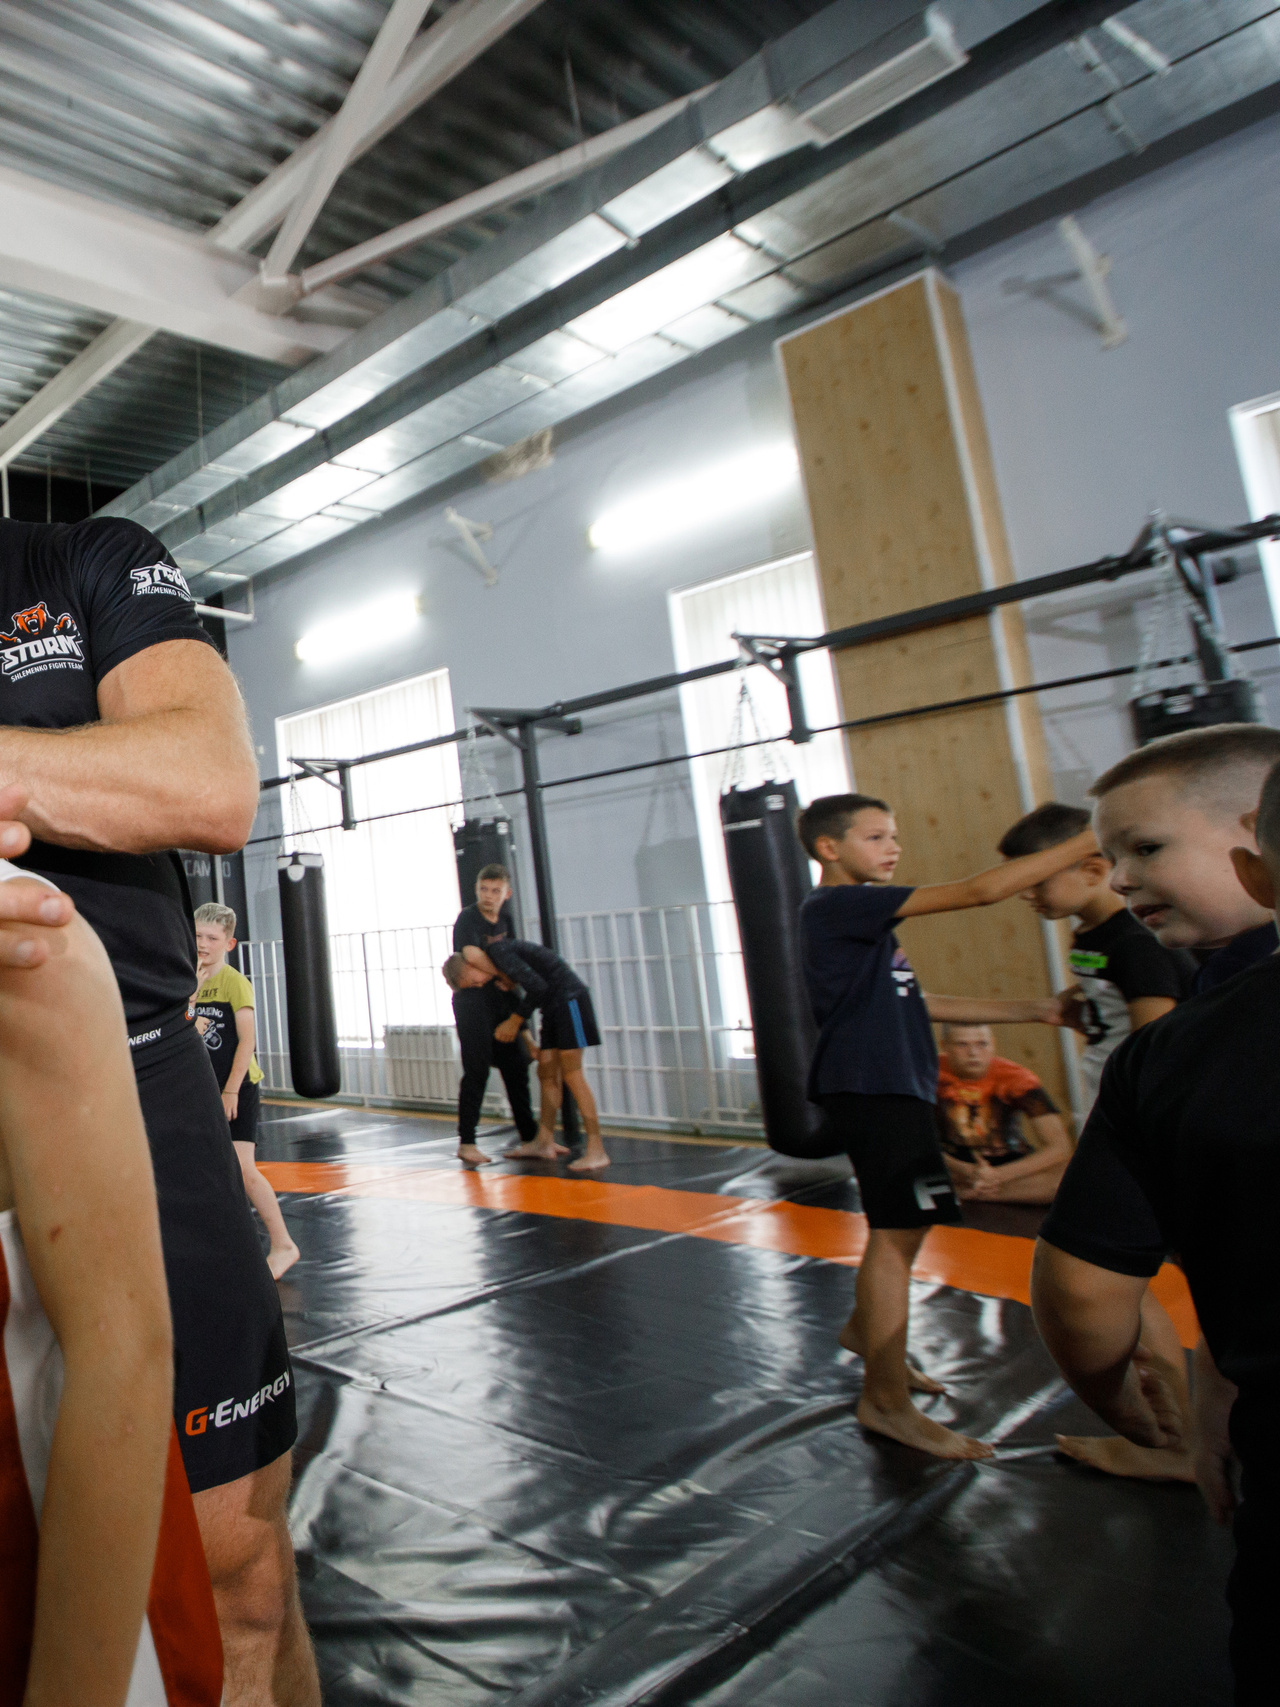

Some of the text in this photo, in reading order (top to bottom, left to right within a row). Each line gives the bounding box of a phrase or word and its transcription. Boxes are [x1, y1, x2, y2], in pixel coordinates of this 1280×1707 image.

[0, 634, 82, 672] STORM
[10, 661, 84, 683] SHLEMENKO FIGHT TEAM
[125, 1028, 162, 1047] NERGY
